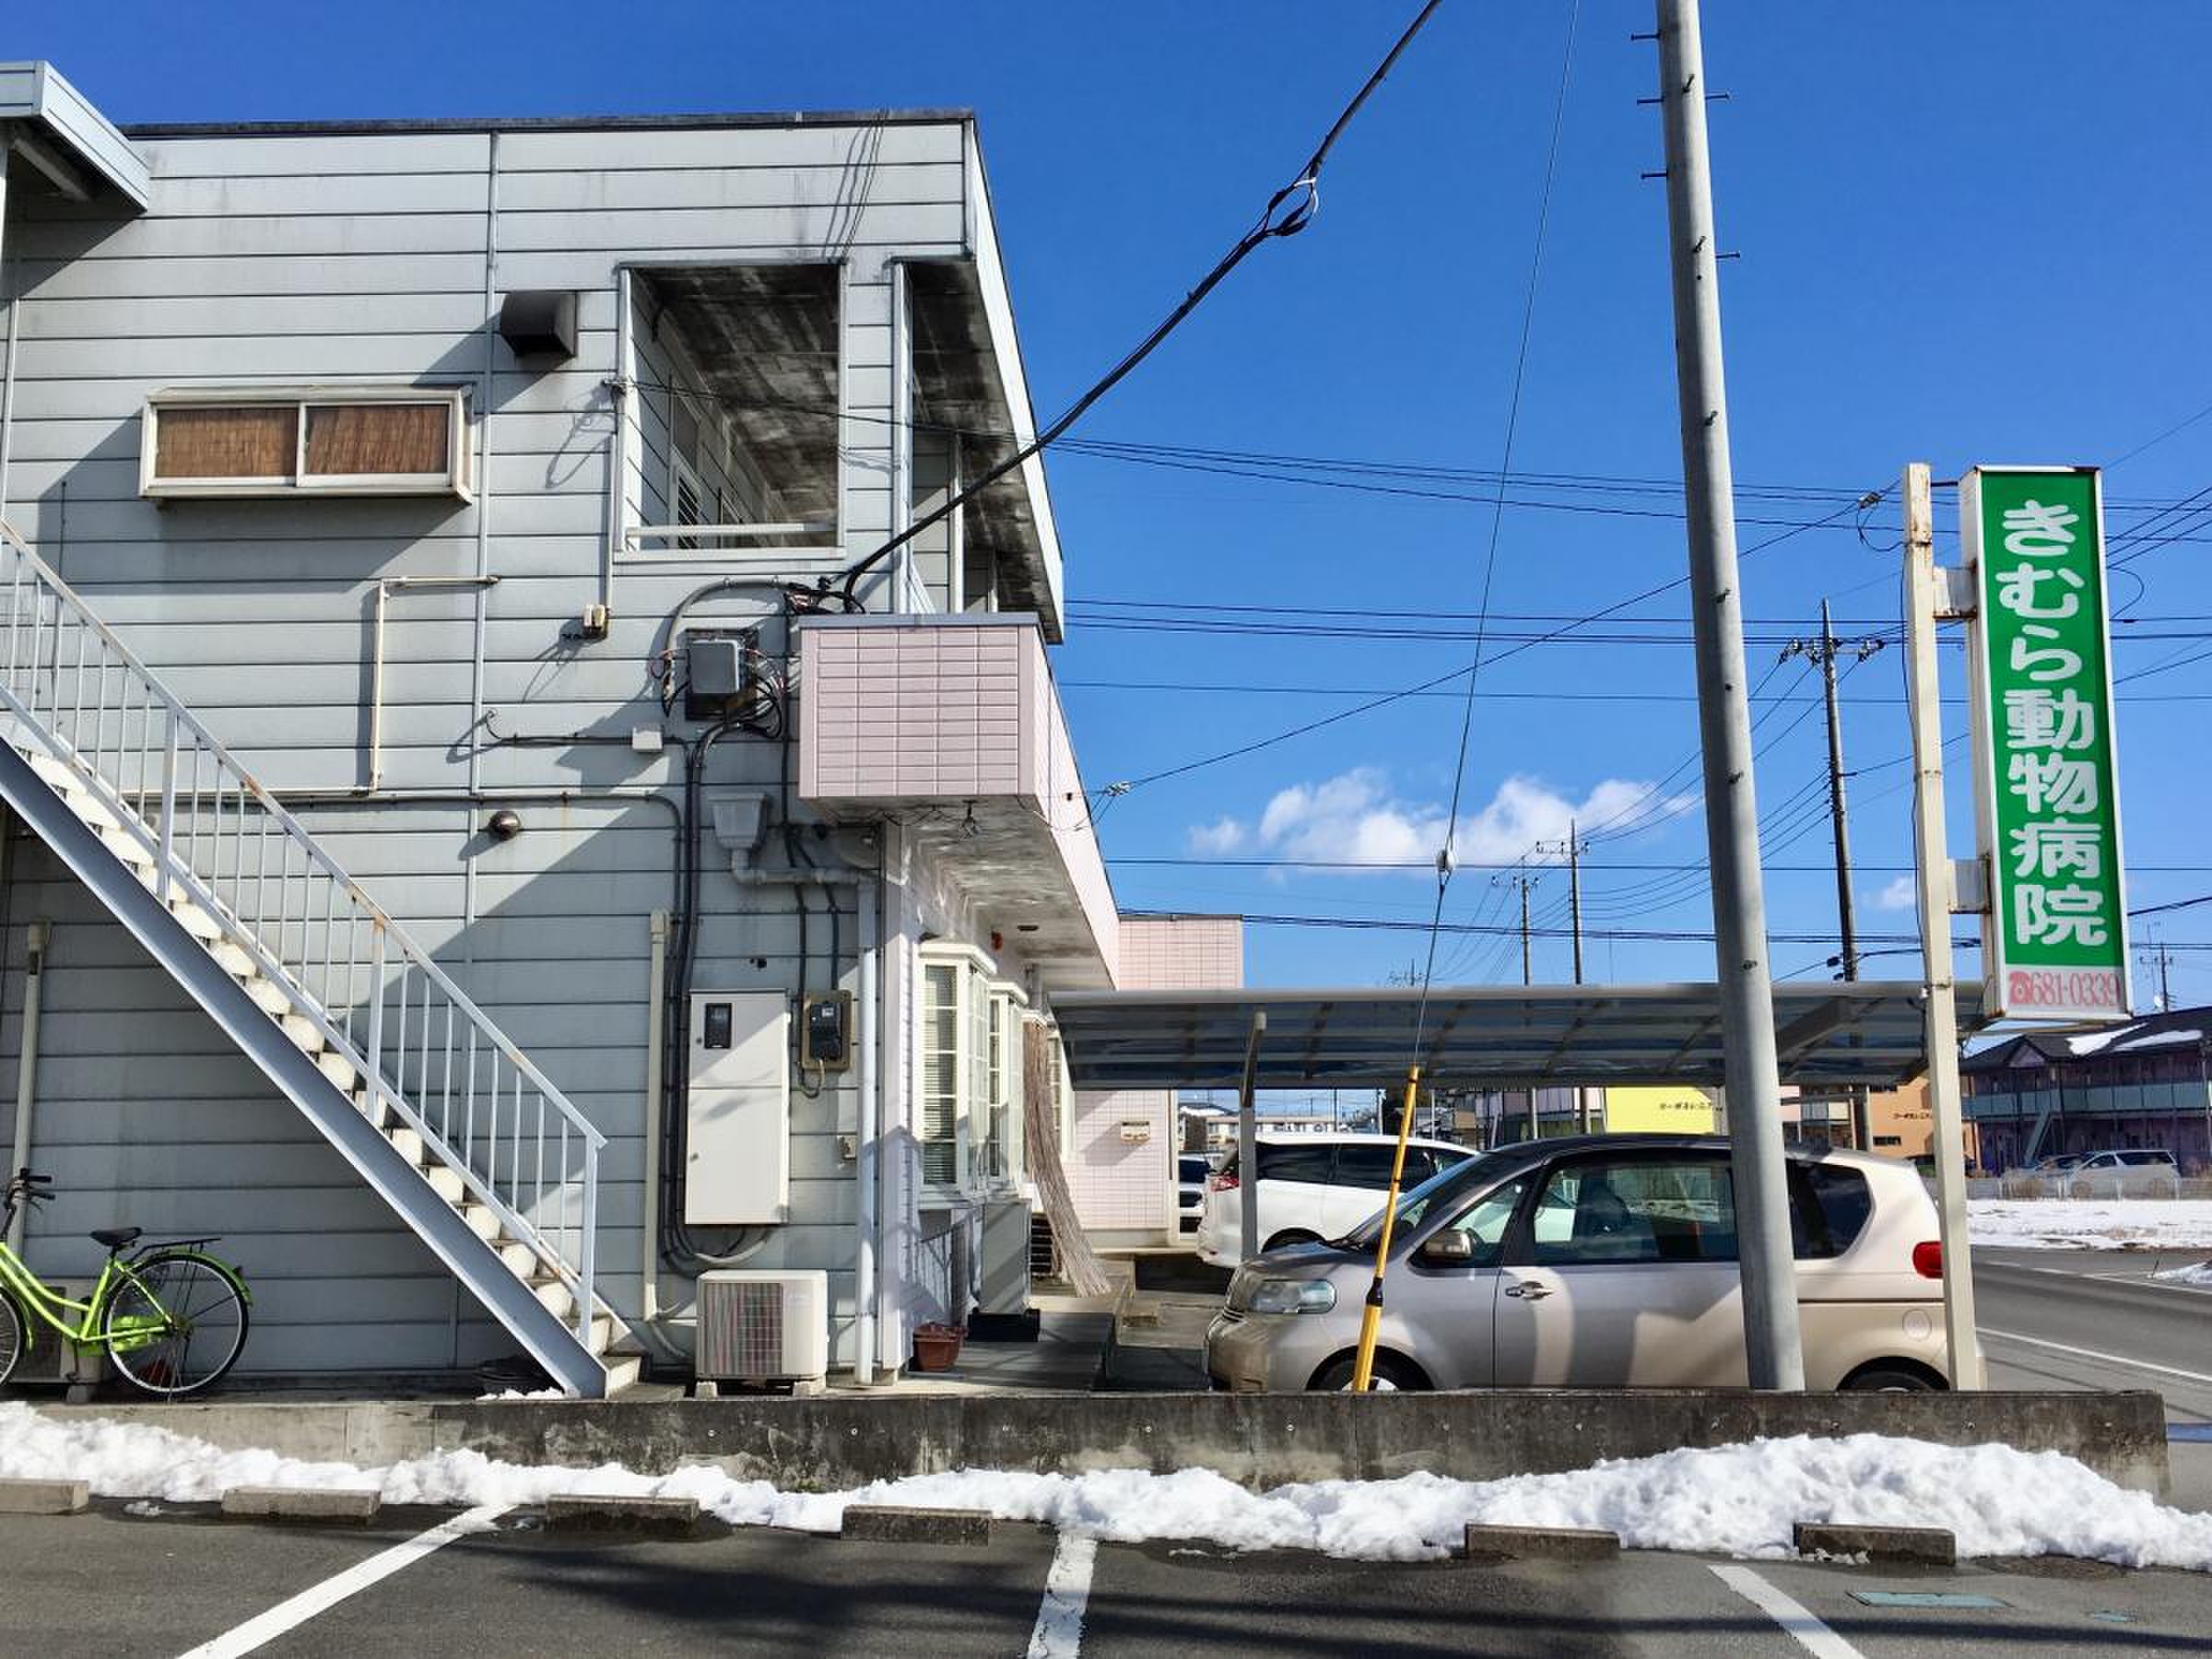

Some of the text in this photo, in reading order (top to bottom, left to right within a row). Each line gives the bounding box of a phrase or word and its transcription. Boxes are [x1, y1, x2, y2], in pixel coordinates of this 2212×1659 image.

[1995, 499, 2107, 947] きむら動物病院
